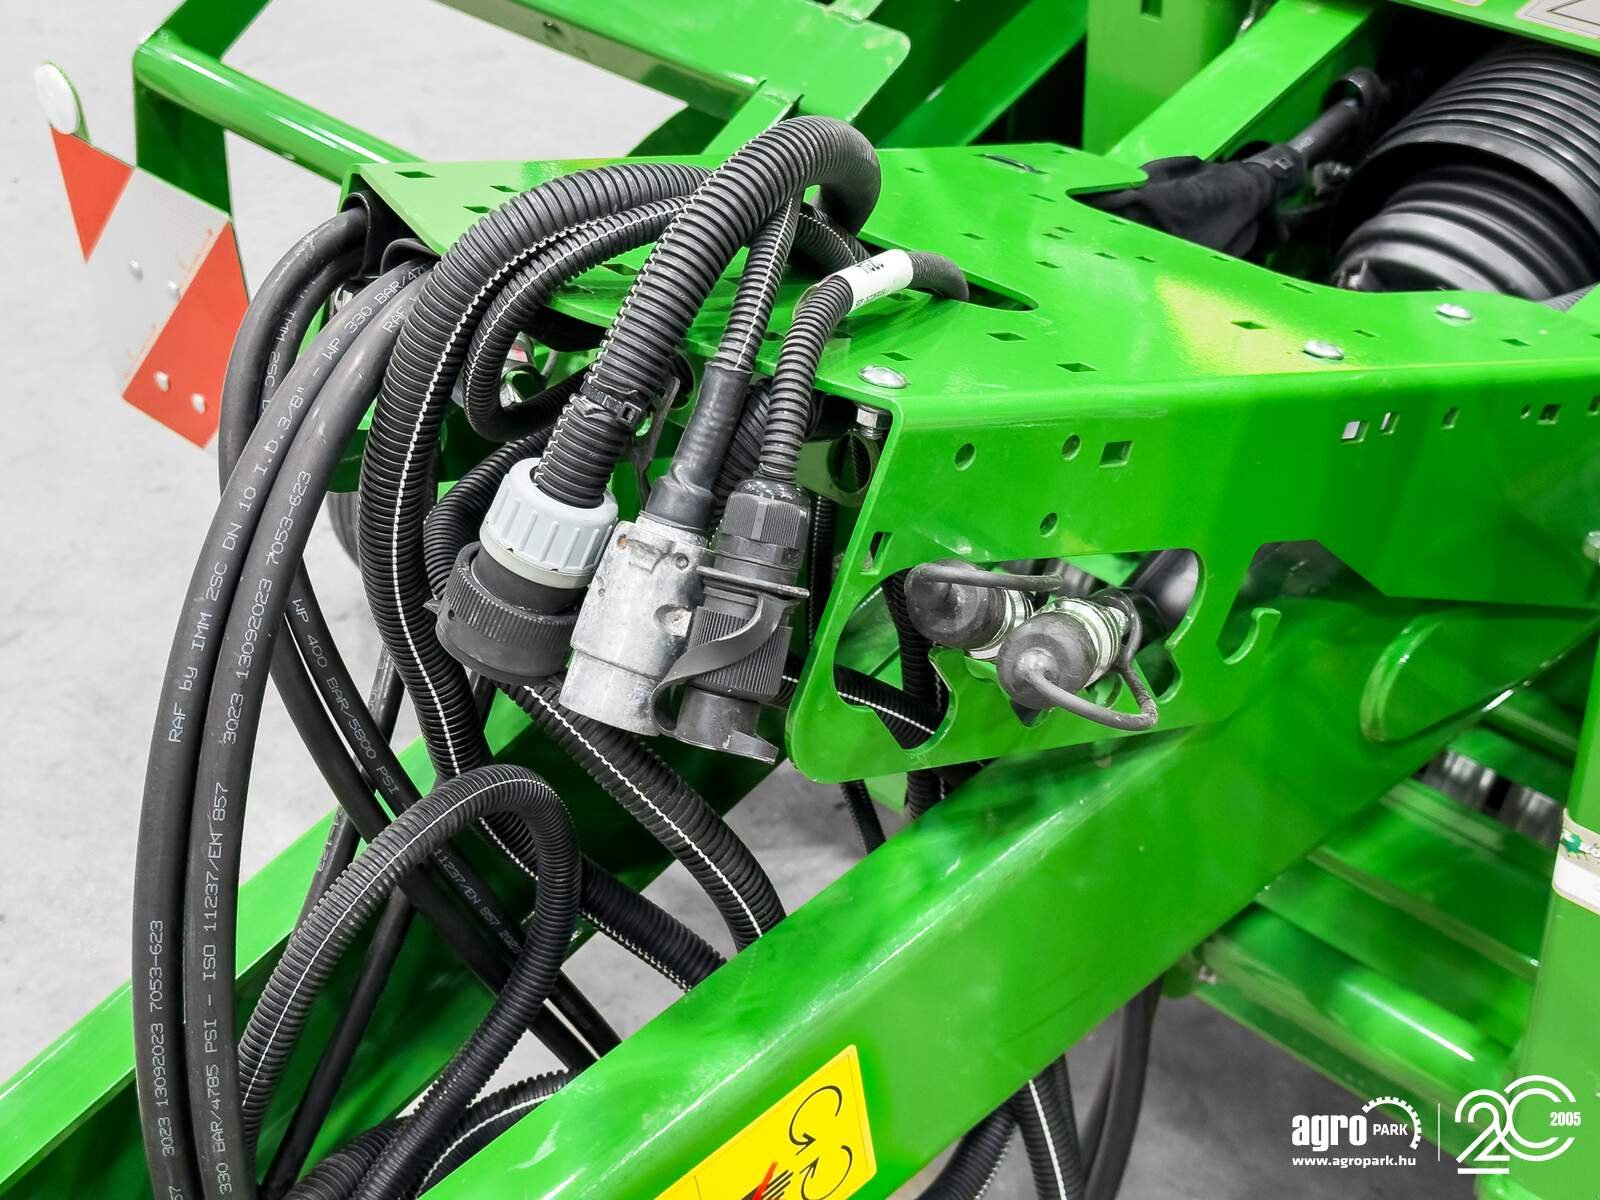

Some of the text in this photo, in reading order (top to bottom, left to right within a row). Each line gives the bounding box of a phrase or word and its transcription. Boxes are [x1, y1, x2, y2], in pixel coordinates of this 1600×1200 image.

[382, 305, 407, 334] RAF
[168, 703, 187, 743] RAF
[179, 666, 198, 691] by
[191, 612, 212, 652] IMM
[206, 561, 228, 601] 2SC
[222, 522, 243, 551] DN
[240, 486, 257, 513] 10
[321, 337, 341, 361] WP
[344, 305, 373, 334] 330
[223, 470, 312, 744] 3023 13092023 7053-623
[292, 598, 400, 795] WP 400 BAR/5800 PSI
[212, 782, 229, 822] 857
[203, 944, 216, 981] ISO
[149, 919, 176, 1157] 3023 13092023 7053-623
[203, 1018, 218, 1054] PSI
[205, 1063, 226, 1153] BAR/4785
[216, 1161, 233, 1196] 330
